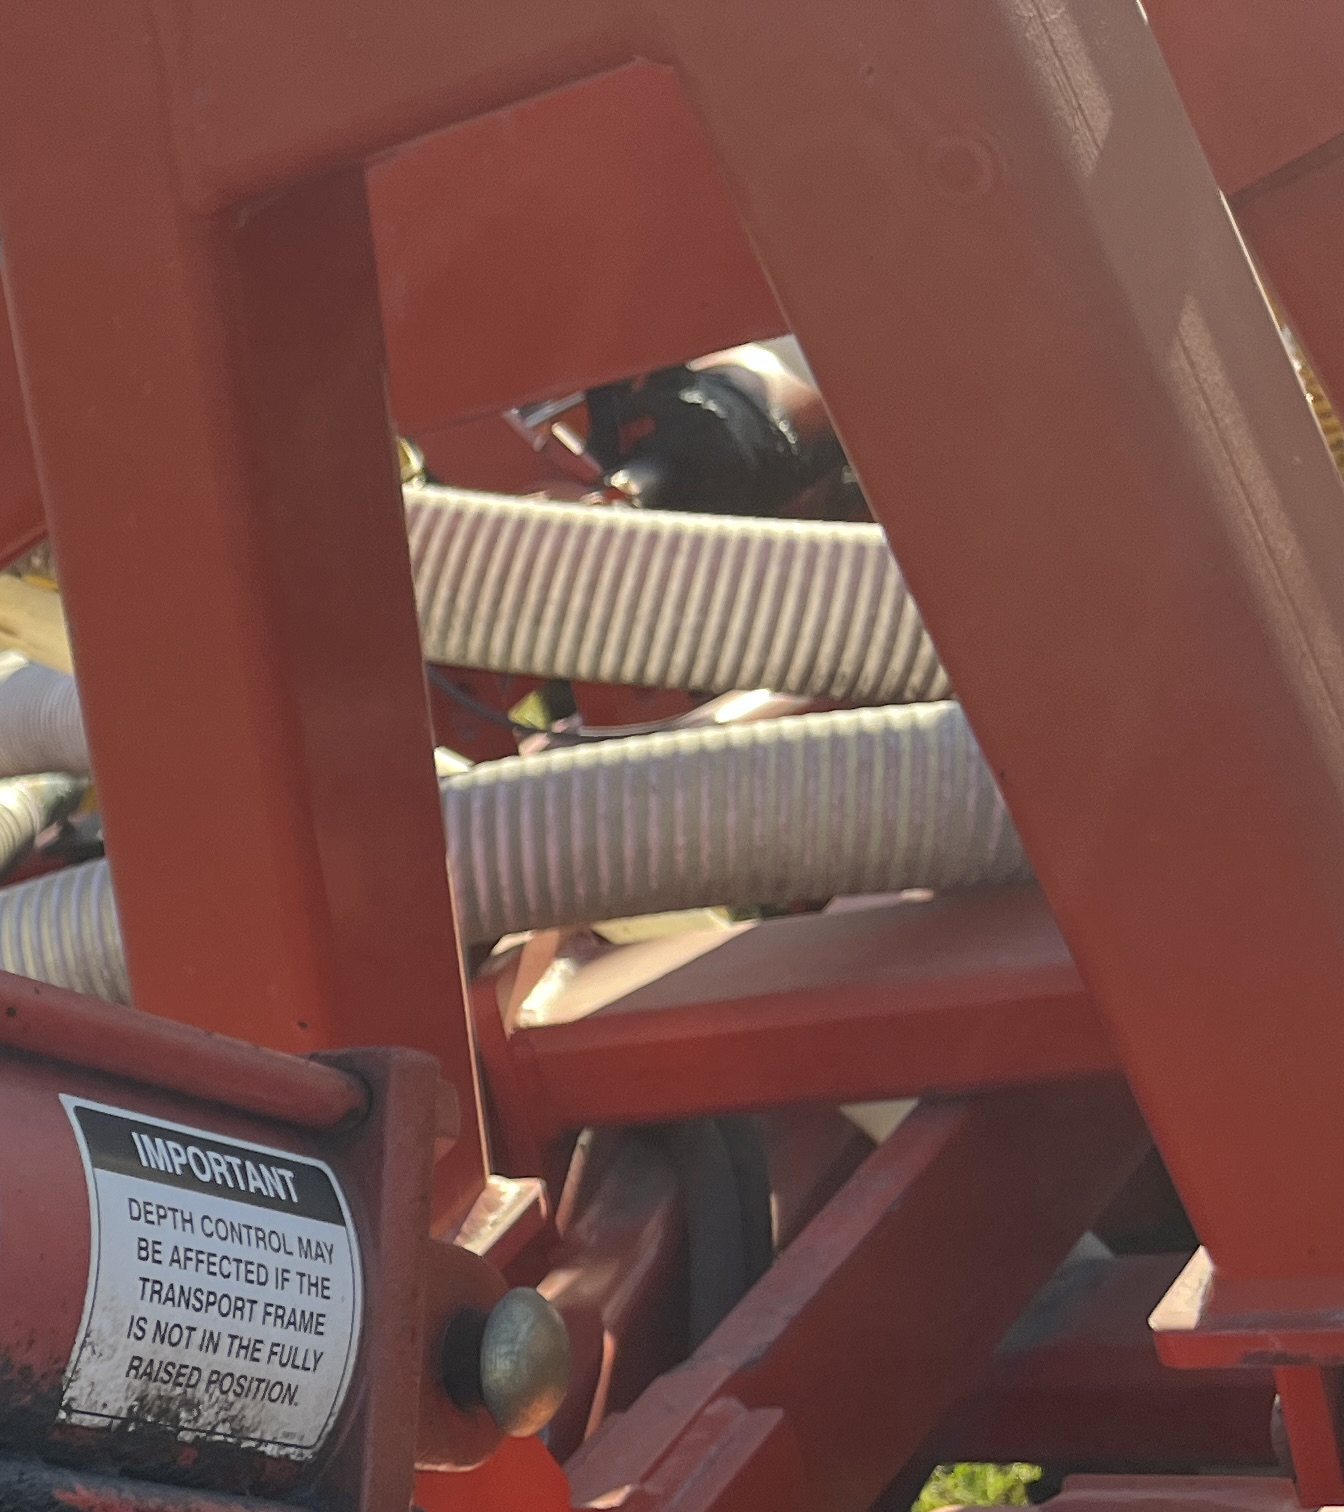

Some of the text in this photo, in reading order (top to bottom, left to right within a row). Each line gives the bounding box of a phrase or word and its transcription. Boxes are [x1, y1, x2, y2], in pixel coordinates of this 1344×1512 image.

[131, 1131, 298, 1203] IMPORTANT
[128, 1198, 334, 1265] DEPTH CONTROL MAY
[137, 1237, 331, 1300] BE AFFECTED IF THE
[139, 1277, 326, 1336] TRANSPORT FRAME
[127, 1315, 323, 1373] IS NOT IN THE FULLY
[125, 1355, 299, 1406] RAISED POSITION.
